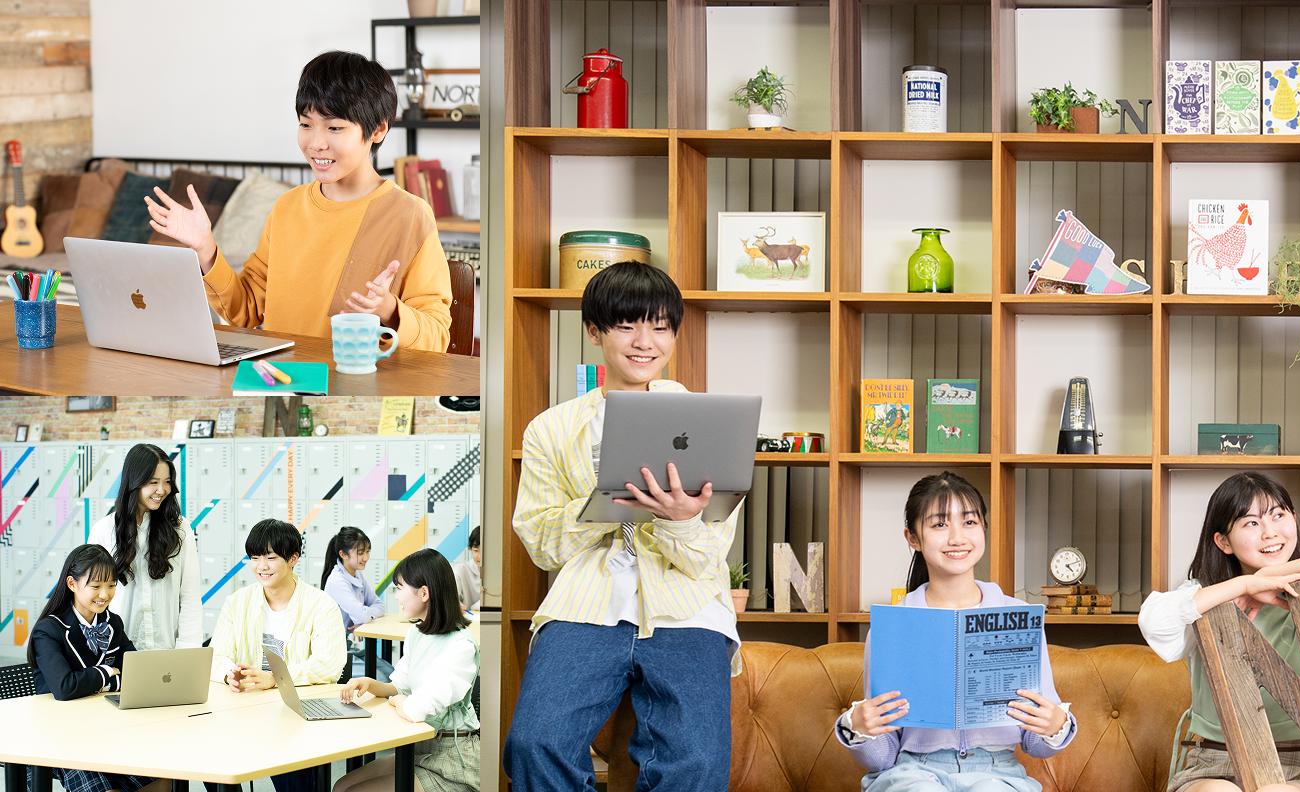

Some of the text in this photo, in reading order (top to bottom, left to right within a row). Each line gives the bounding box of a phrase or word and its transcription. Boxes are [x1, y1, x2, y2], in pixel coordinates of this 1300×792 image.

[911, 82, 938, 91] NATIONAL
[908, 91, 940, 99] DRIED MILK
[1181, 106, 1198, 114] WAR
[1115, 99, 1152, 134] N
[1197, 203, 1225, 214] CHICKEN
[1210, 215, 1225, 225] RICE
[1064, 220, 1104, 249] GOOD LUCK
[773, 541, 825, 613] N
[965, 611, 1042, 634] ENGLISH 13
